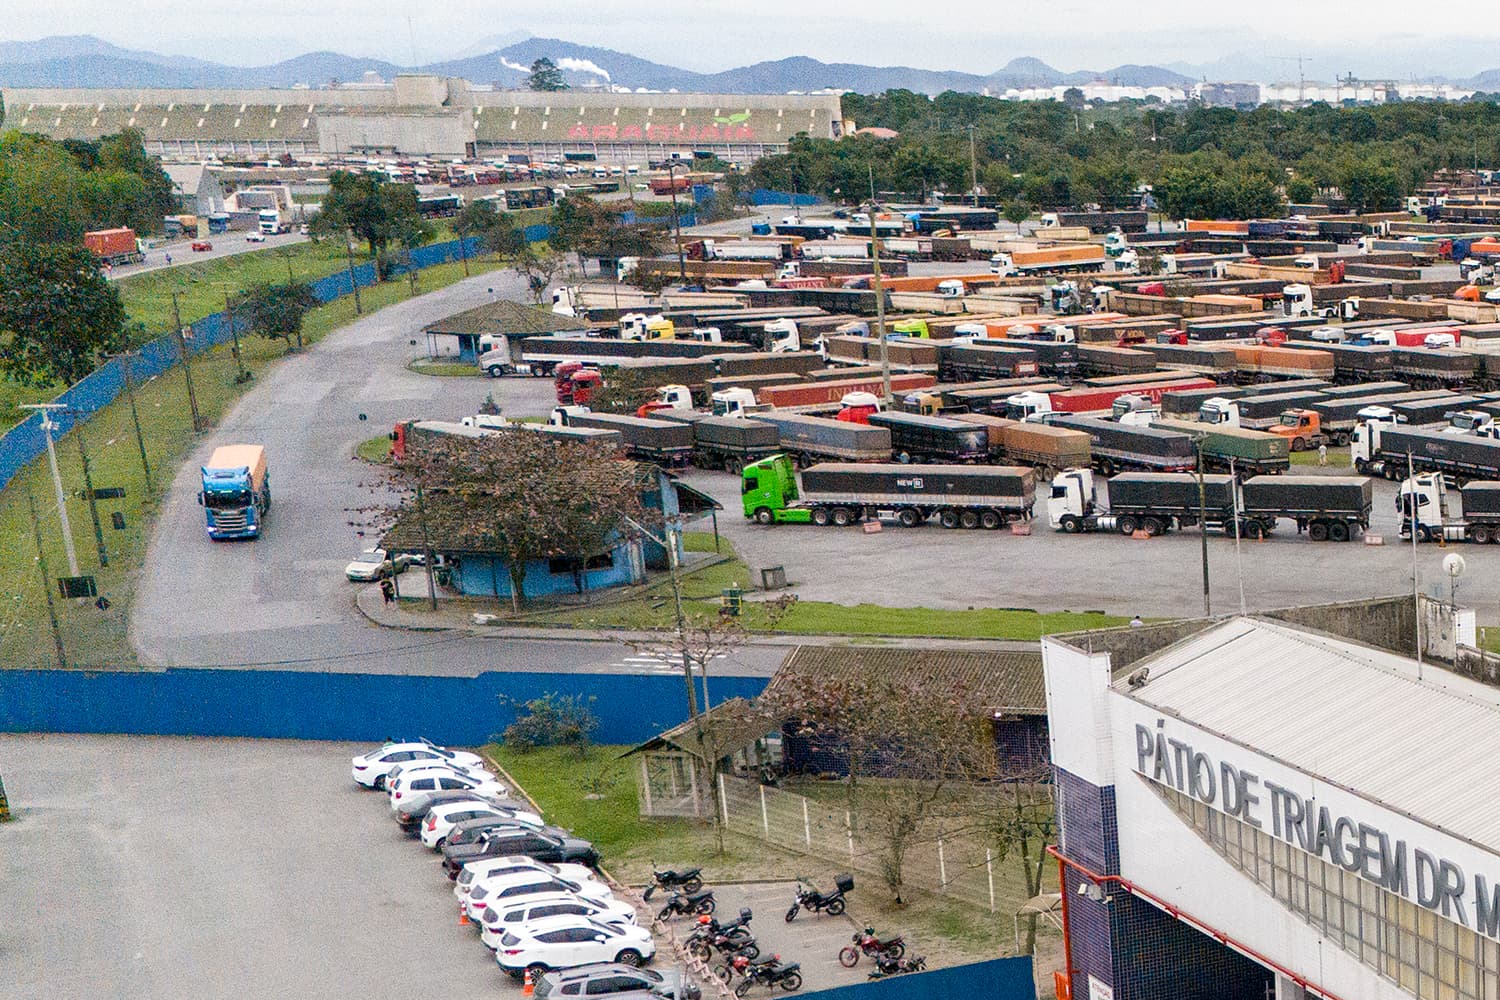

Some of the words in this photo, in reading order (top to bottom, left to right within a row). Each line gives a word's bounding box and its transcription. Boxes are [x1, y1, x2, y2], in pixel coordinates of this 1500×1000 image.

[1136, 719, 1216, 804] PÁTIO
[1220, 760, 1263, 829] DE
[1264, 779, 1409, 898] TRIAGEM
[1414, 847, 1469, 927] DR
